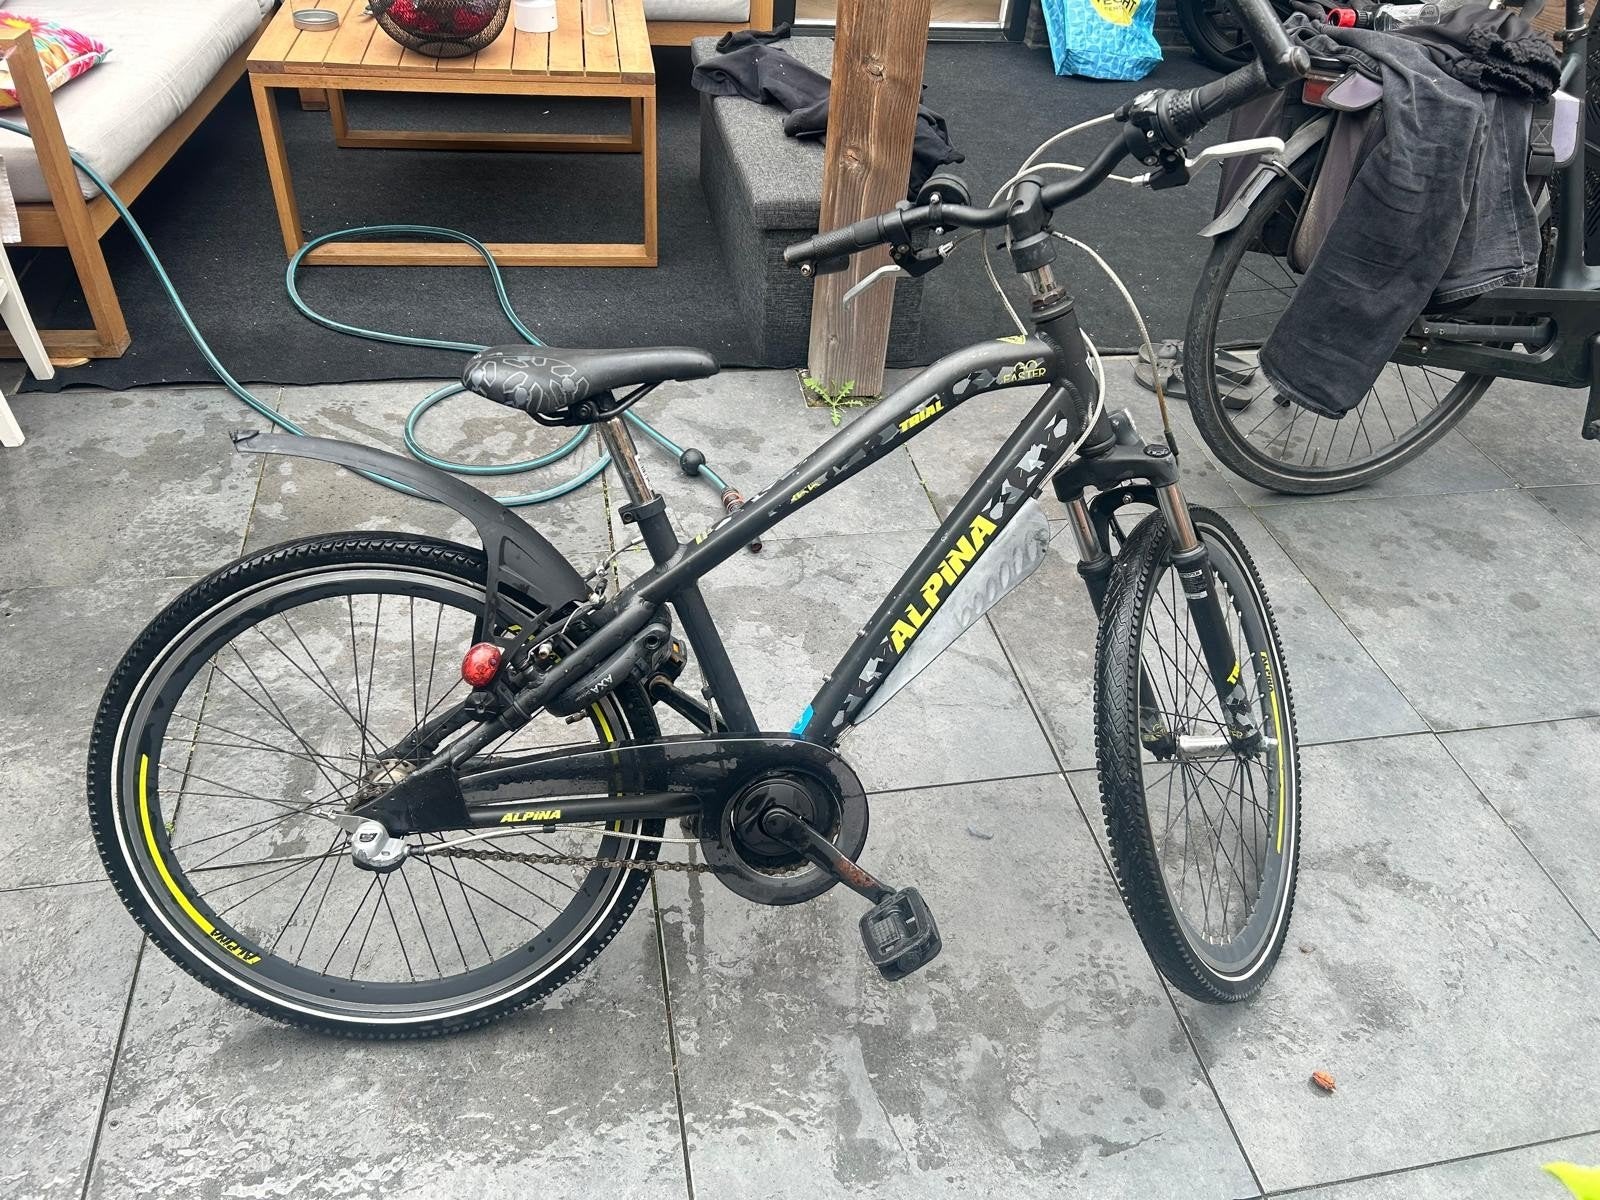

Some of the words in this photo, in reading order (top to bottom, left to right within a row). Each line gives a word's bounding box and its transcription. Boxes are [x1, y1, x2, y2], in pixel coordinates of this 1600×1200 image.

[1013, 359, 1038, 374] GO
[1003, 367, 1047, 384] FASTER
[899, 400, 945, 433] TRIAL
